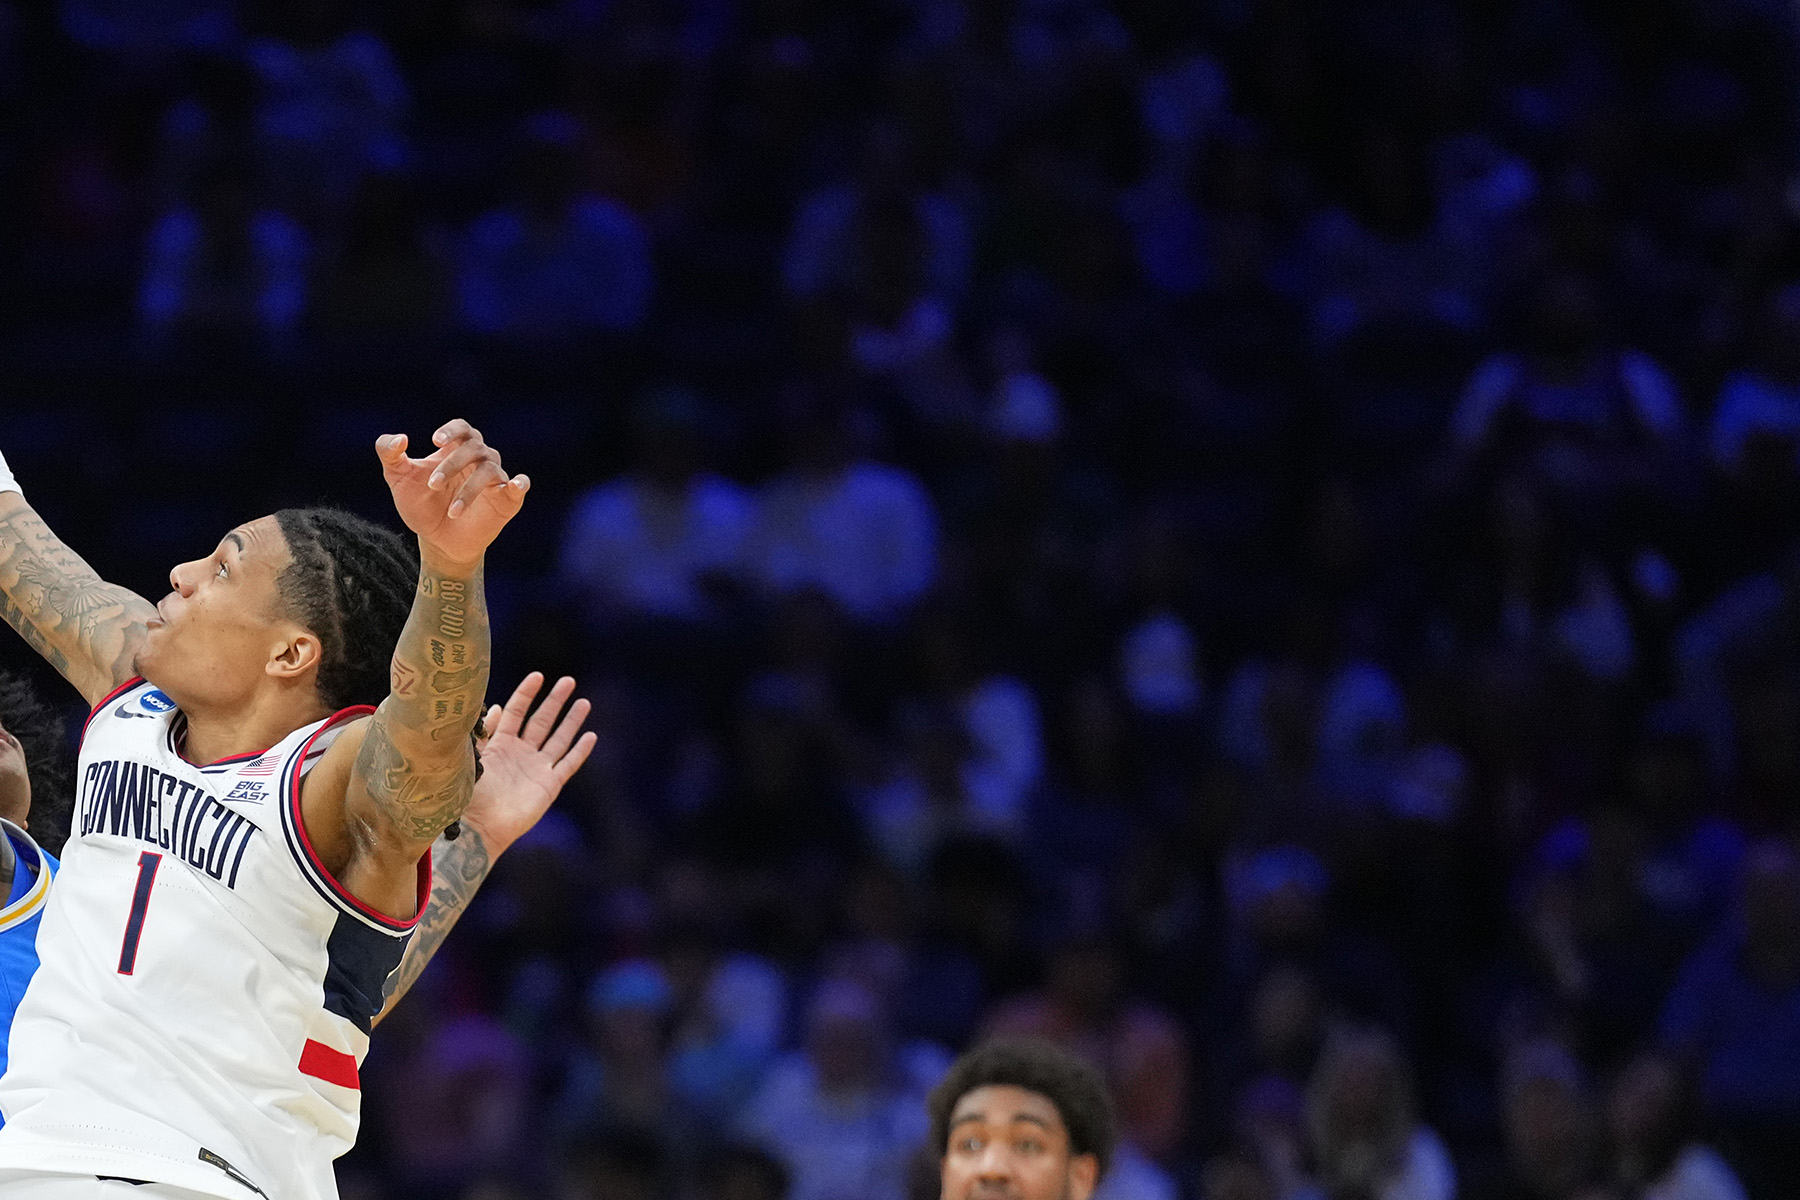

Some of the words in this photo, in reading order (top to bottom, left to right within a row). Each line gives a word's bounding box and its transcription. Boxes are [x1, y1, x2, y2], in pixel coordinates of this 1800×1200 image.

[227, 791, 271, 802] EAST
[234, 780, 266, 791] BIG
[80, 760, 263, 890] CONNECTICUT
[116, 850, 164, 976] 1
